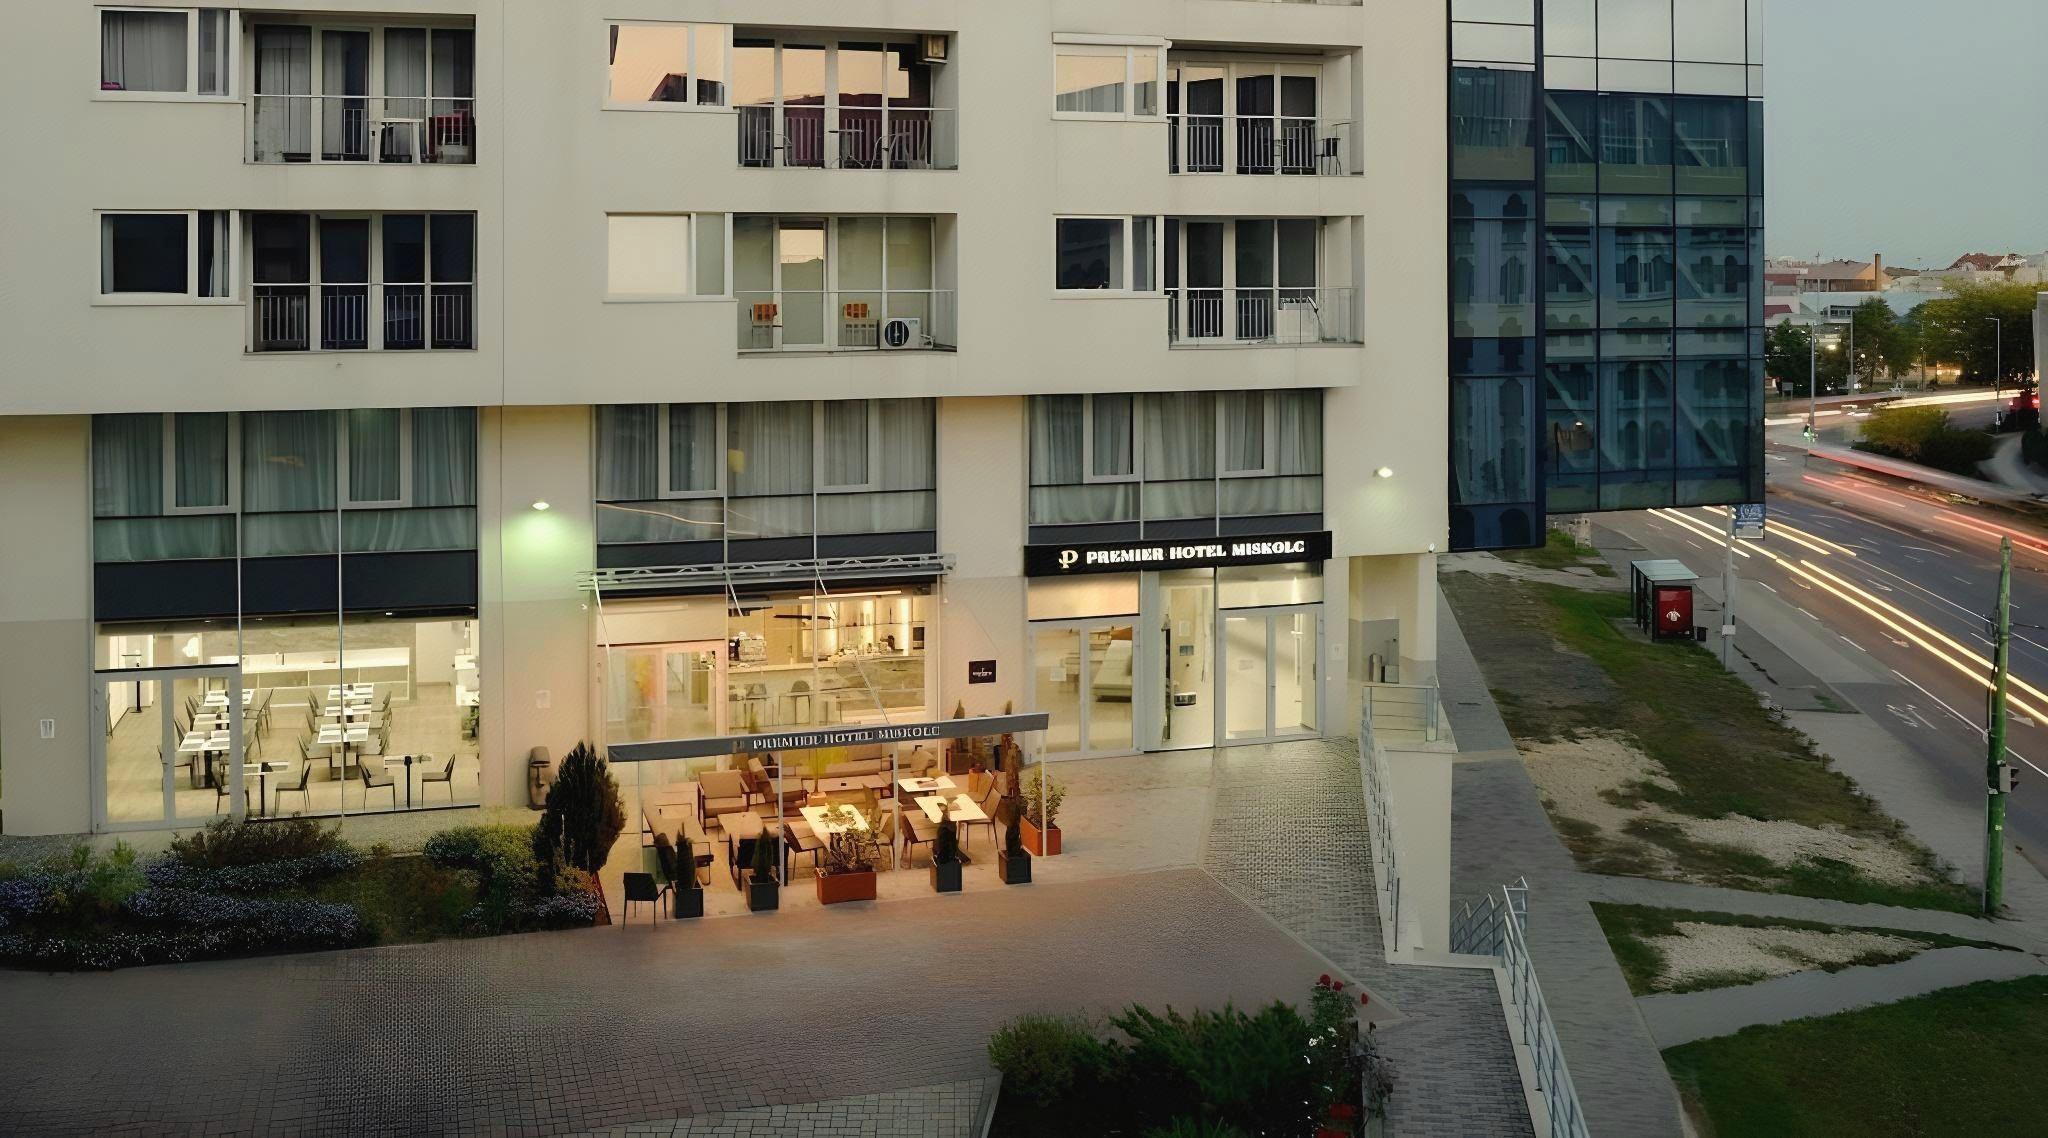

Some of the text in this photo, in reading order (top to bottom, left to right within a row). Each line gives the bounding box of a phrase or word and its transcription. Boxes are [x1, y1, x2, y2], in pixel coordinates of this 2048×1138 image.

[1086, 547, 1164, 565] PREMIER
[1169, 544, 1227, 560] HOTEL
[1231, 540, 1305, 557] MISKOLC
